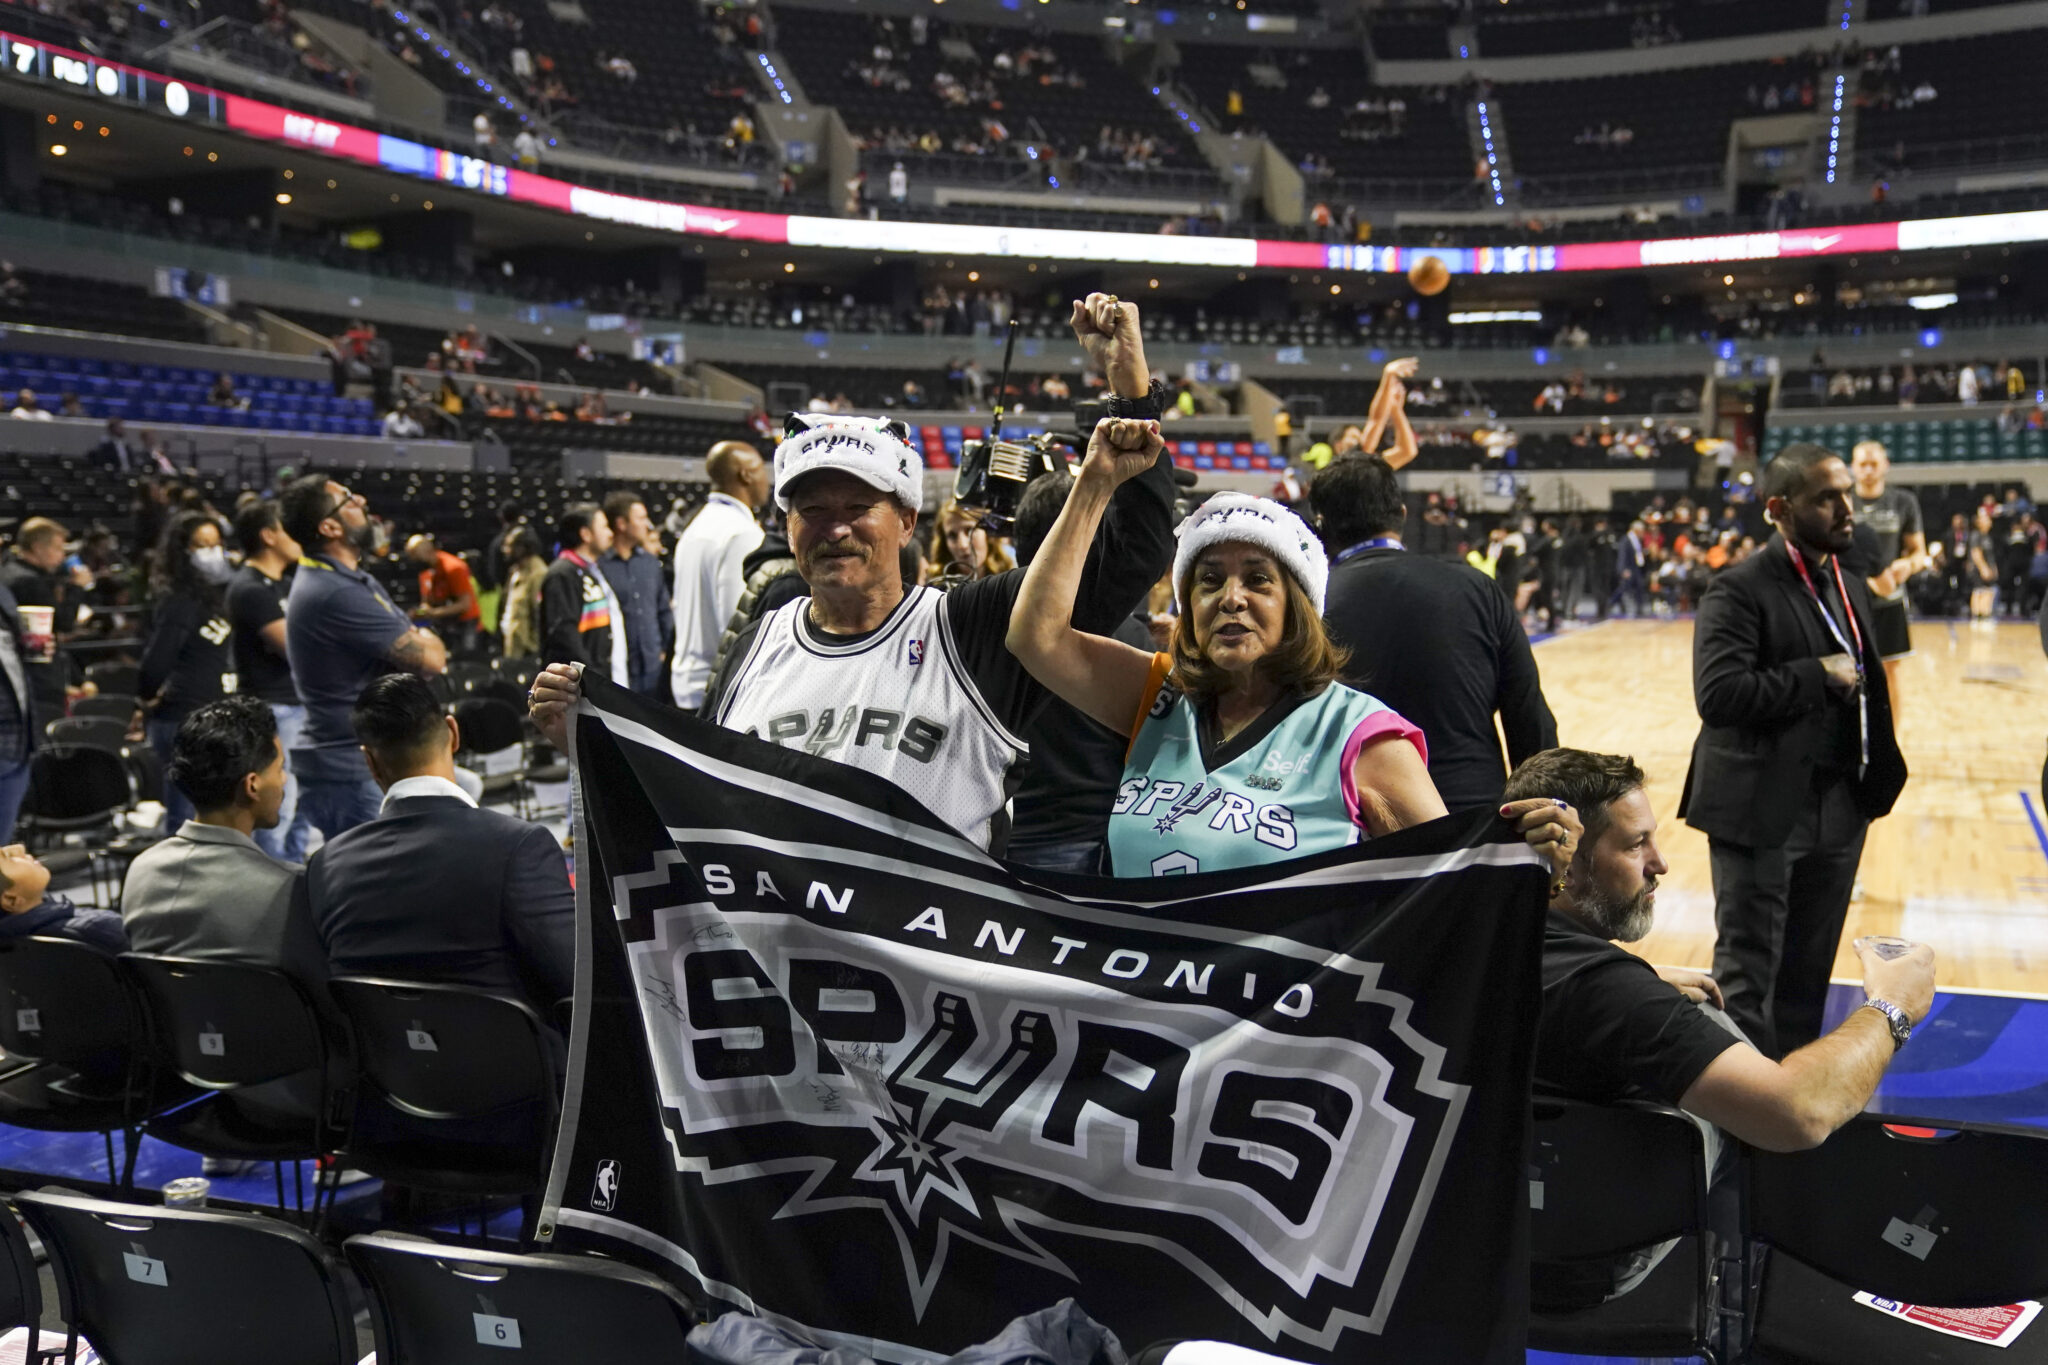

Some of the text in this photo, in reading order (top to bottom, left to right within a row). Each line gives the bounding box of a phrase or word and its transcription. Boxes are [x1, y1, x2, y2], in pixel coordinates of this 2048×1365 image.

[745, 695, 949, 764] PURS
[1112, 776, 1297, 851] SPURS
[703, 863, 1314, 1018] SAN ANTONIO
[684, 949, 1354, 1226] SPURS
[142, 1261, 152, 1276] 7
[1900, 1233, 1914, 1246] 3
[494, 1323, 506, 1340] 6
